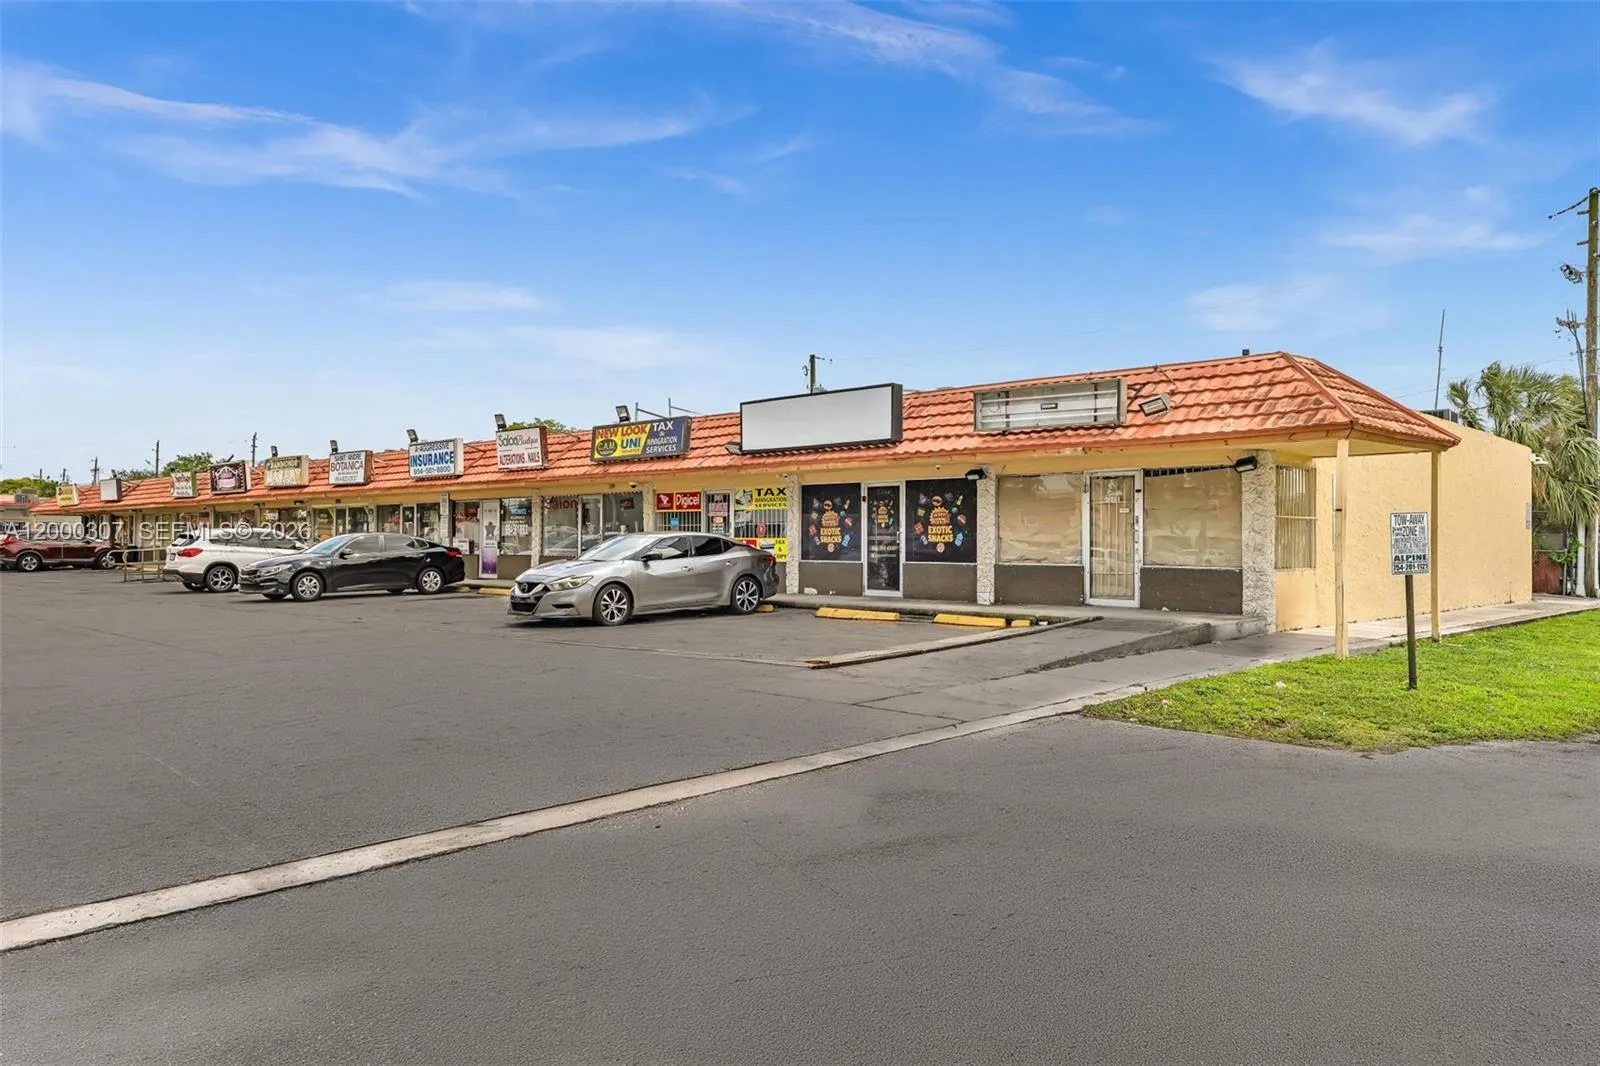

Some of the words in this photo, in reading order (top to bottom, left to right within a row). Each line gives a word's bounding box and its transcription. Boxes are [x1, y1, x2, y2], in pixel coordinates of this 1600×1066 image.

[597, 428, 618, 438] NEW
[621, 424, 647, 436] LOOK
[653, 421, 674, 431] TAX
[621, 438, 641, 449] UNI
[646, 444, 677, 454] SERVICES
[410, 451, 454, 467] INSURANCE
[331, 460, 363, 472] BOTANICA
[755, 487, 786, 496] TAX
[676, 494, 700, 508] Digicel
[1393, 514, 1424, 526] TOW-AWAY
[820, 527, 841, 535] EXOTIC
[928, 525, 953, 534] EXOTIC
[1402, 526, 1417, 536] ZONE
[820, 535, 842, 543] SNACKS
[928, 534, 954, 543] SNACKS
